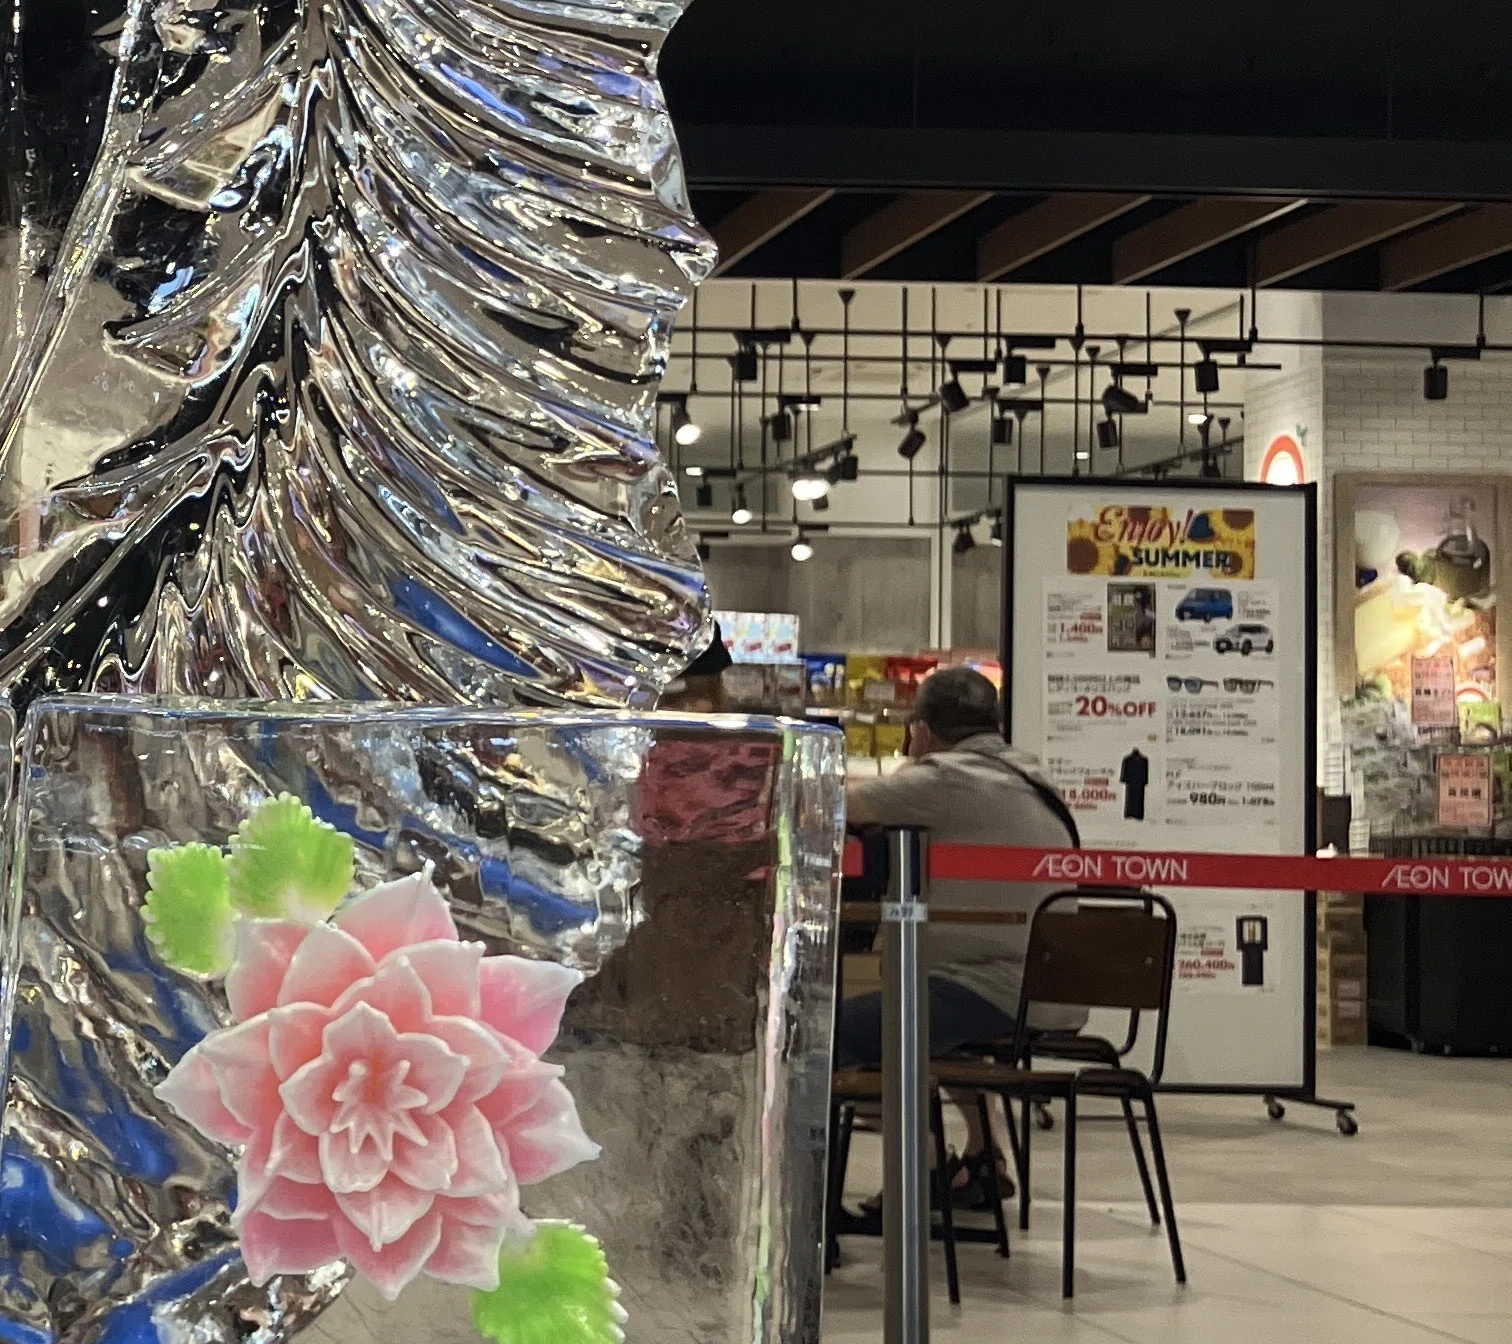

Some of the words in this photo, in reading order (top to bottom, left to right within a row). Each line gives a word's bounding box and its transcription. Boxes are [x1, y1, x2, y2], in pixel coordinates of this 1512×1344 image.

[1093, 506, 1193, 548] Enjoy!
[1130, 547, 1232, 569] SUMMER
[1112, 855, 1187, 881] TOWN
